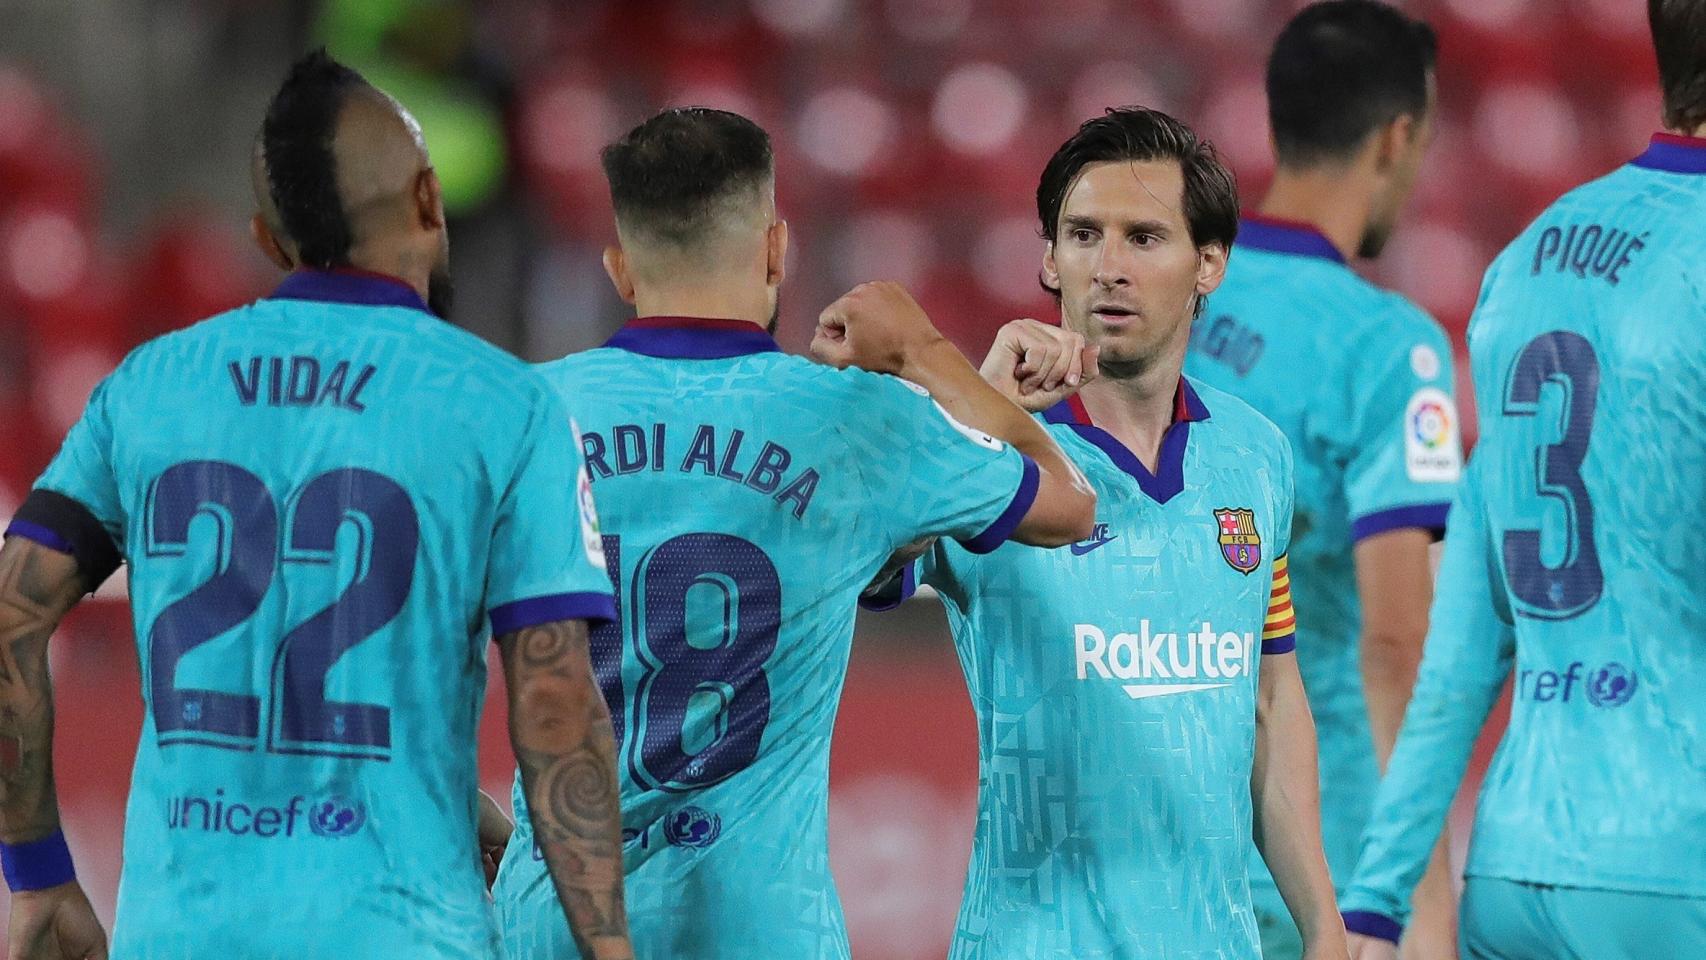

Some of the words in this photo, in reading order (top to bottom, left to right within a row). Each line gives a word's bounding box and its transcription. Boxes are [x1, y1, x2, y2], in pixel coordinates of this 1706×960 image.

[1531, 224, 1650, 288] PIQUÉ
[228, 355, 377, 413] VIDAL
[680, 424, 821, 520] ALBA
[1502, 329, 1605, 622] 3
[1231, 535, 1249, 544] FCB
[145, 460, 420, 762] 22
[588, 532, 782, 794] 18
[168, 788, 304, 837] unicef
